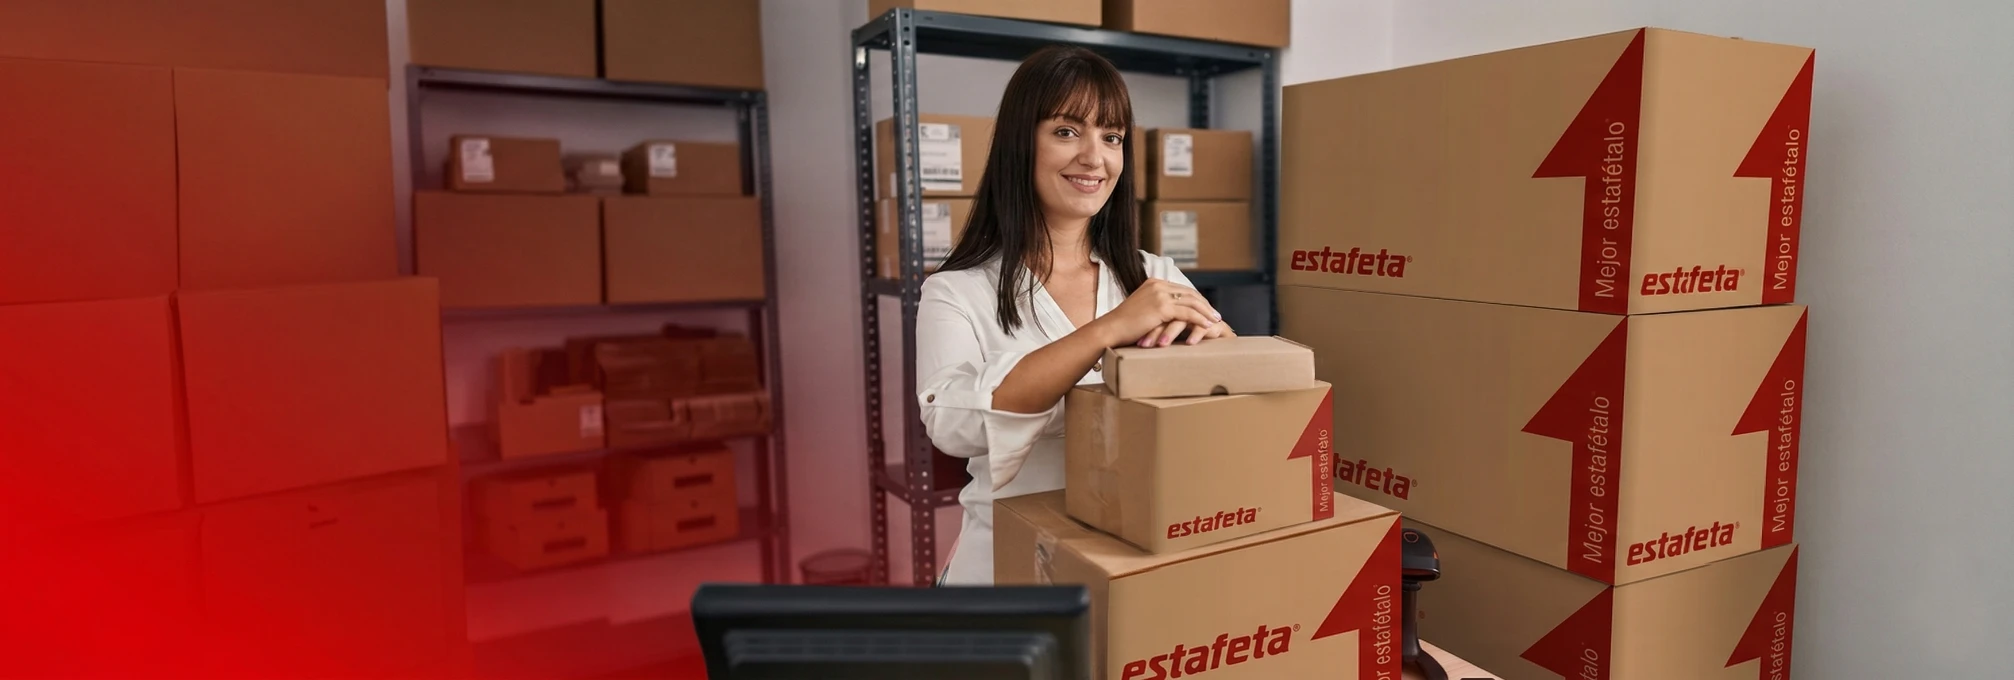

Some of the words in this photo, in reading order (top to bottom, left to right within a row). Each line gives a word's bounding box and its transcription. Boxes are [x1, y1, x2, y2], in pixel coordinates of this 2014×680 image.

[1602, 121, 1625, 230] estafétalo
[1781, 129, 1801, 227] estafétalo
[1291, 246, 1406, 278] estafeta
[1594, 238, 1621, 298] Mejor
[1773, 234, 1792, 290] Mejor
[1588, 396, 1610, 497] estafétalo
[1778, 379, 1796, 471] estafétalo
[1167, 507, 1258, 540] estafeta
[1583, 503, 1608, 563] Mejor
[1772, 478, 1790, 533] Mejor
[1627, 521, 1736, 567] estafeta
[1121, 624, 1293, 680] estafeta
[1372, 585, 1391, 665] estafétalo
